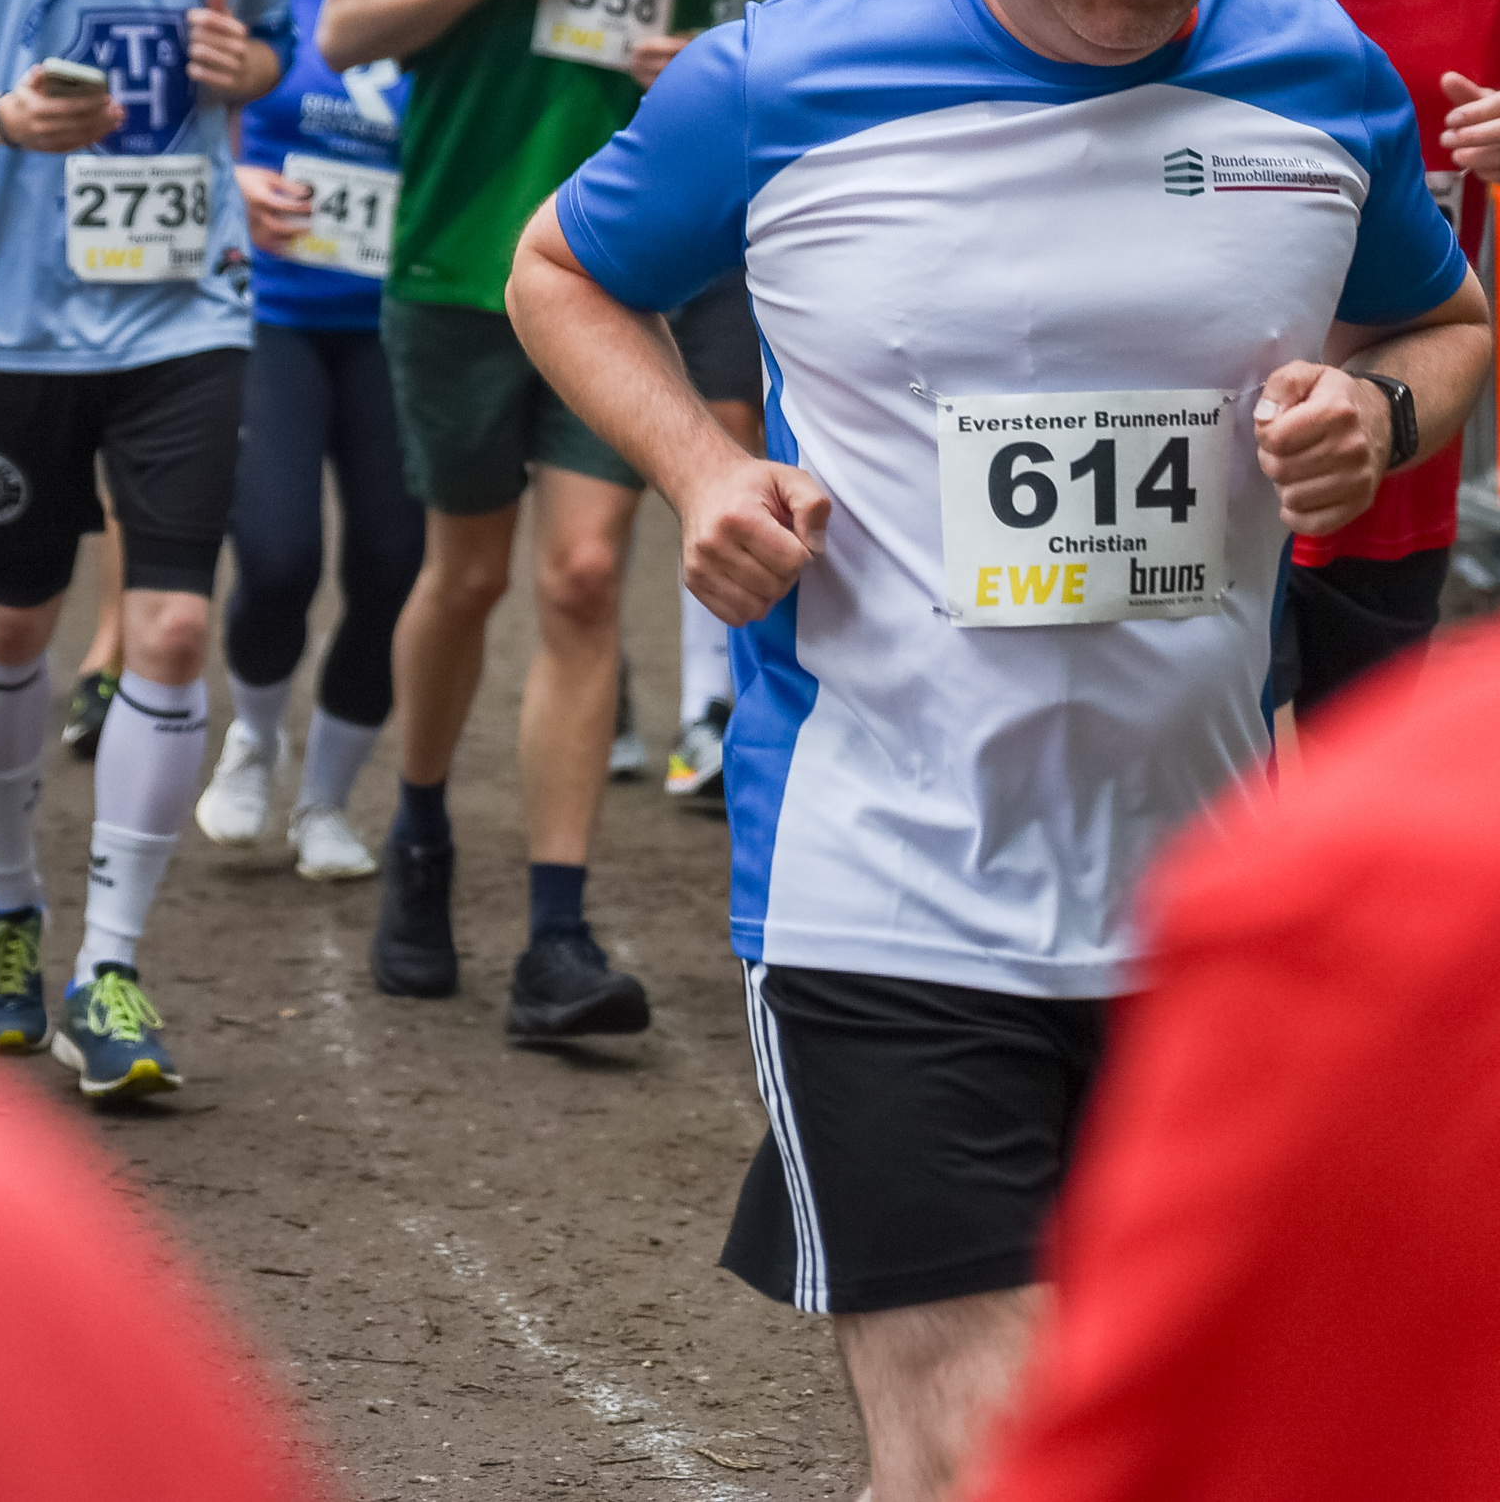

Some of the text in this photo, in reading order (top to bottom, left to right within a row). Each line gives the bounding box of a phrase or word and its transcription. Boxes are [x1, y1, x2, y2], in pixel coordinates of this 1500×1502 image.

[1211, 154, 1303, 169] Bundesanstalt
[74, 181, 209, 229] 2738
[958, 408, 1220, 432] Everstener Brunnenlauf
[988, 436, 1196, 529] 614
[1048, 535, 1148, 553] Christian
[975, 556, 1206, 607] EWE bruns
